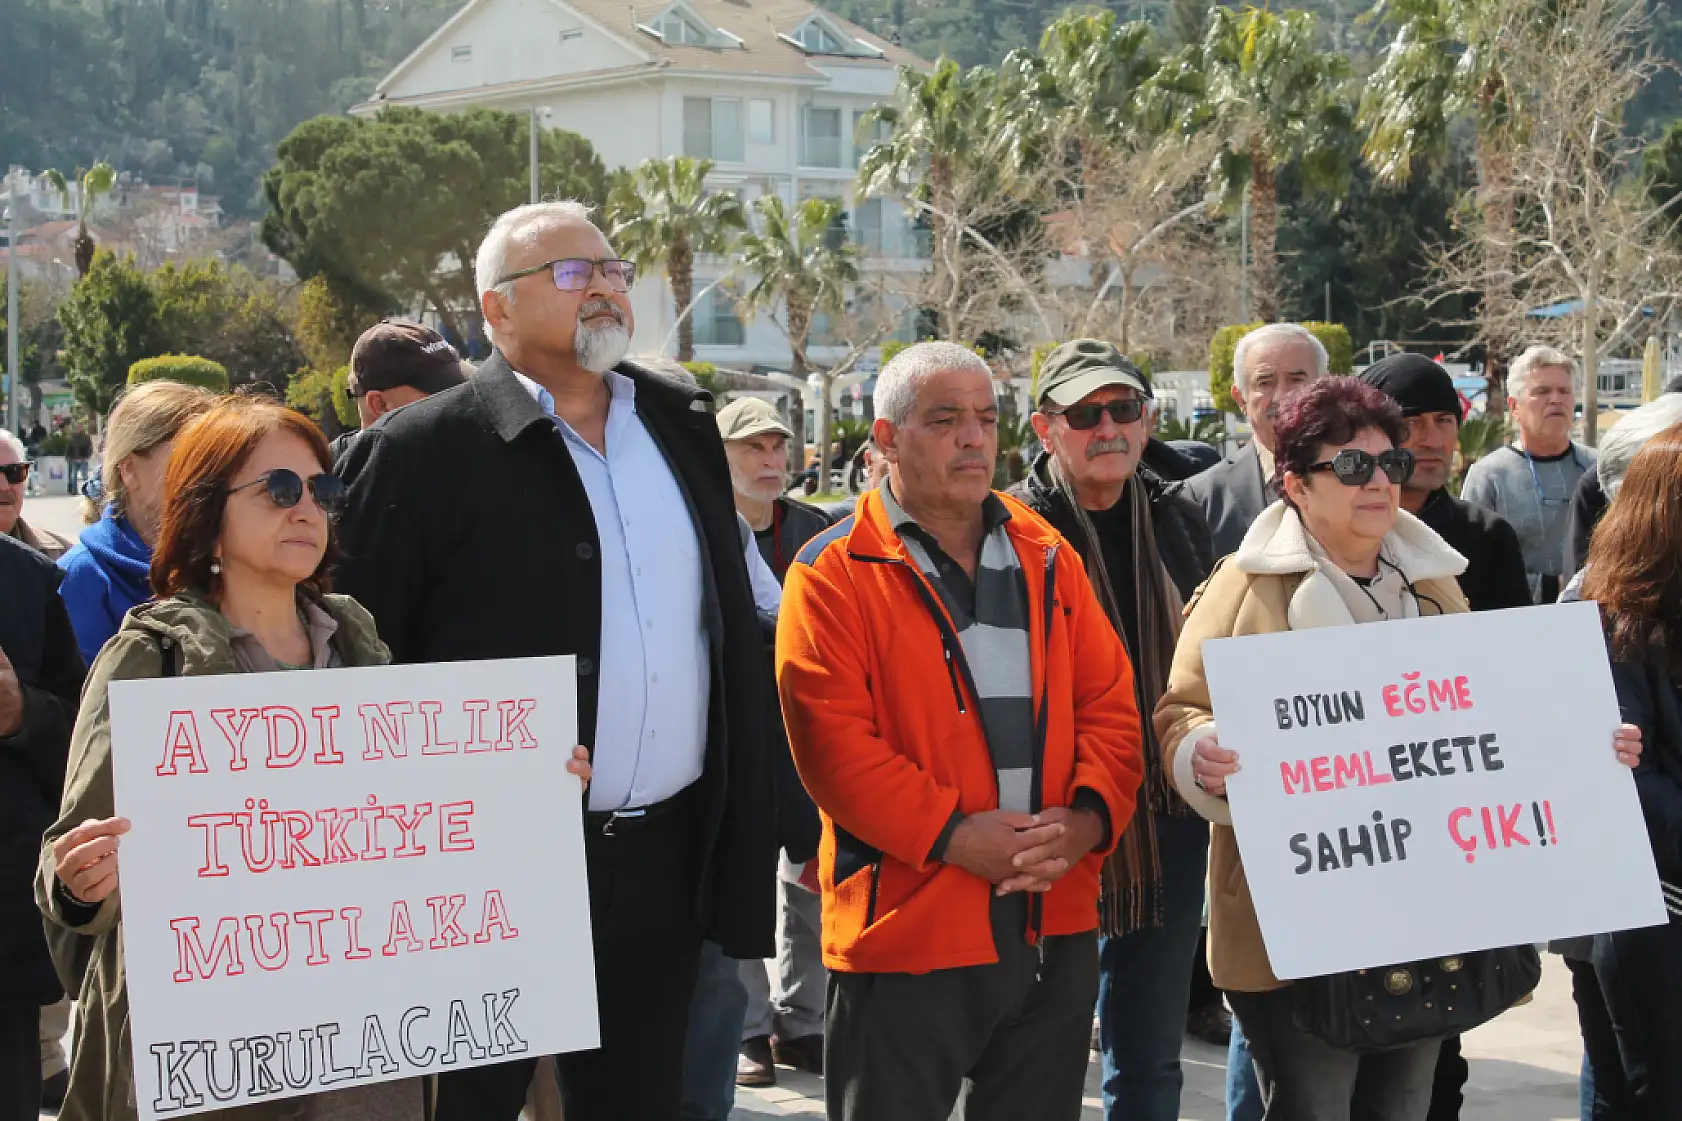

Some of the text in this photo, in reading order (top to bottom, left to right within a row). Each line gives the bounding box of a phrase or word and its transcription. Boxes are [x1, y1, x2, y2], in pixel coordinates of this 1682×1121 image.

[1273, 670, 1473, 730] BOYUN EĞME
[1280, 733, 1504, 795] MEMLEKETE
[187, 794, 475, 878] TÜRKİYE
[1289, 799, 1558, 874] SAHİP ÇIK!!
[169, 889, 519, 983] MUTLAKA
[150, 987, 528, 1113] KURULACAK
